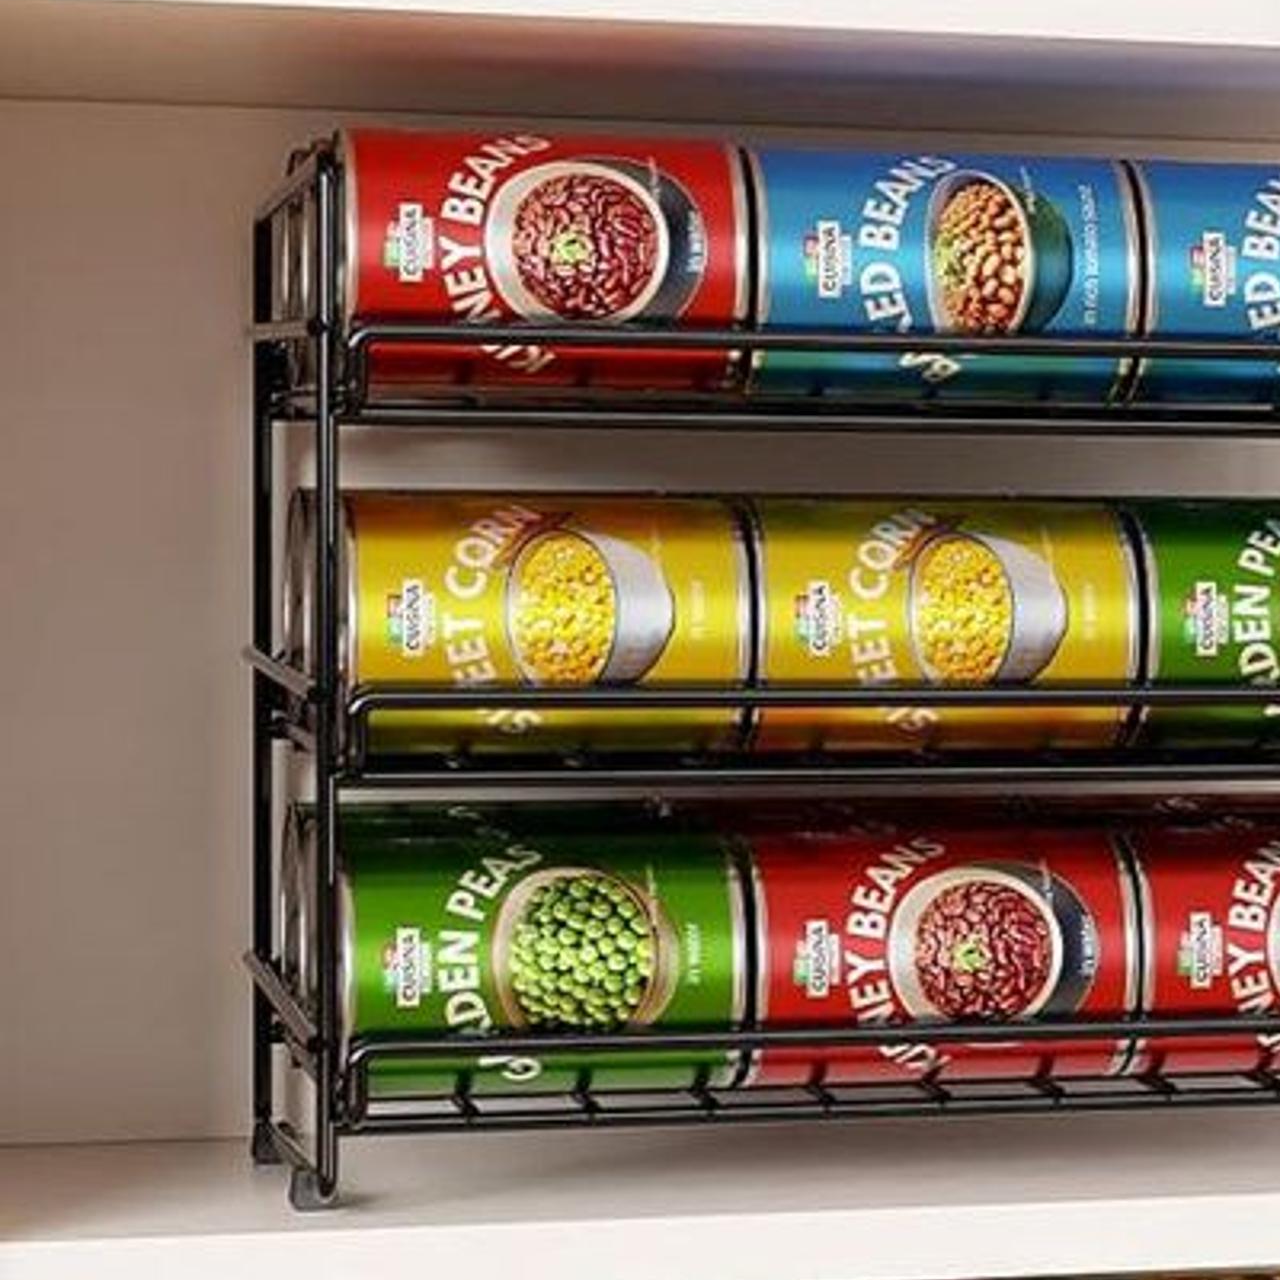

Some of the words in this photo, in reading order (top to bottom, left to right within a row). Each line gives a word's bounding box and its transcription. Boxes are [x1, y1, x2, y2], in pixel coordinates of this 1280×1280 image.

[440, 132, 552, 226] BEANS
[859, 153, 958, 251] BEANS
[444, 504, 542, 600] CORN
[849, 507, 938, 600] CORN
[446, 844, 542, 922] PEAS
[847, 835, 946, 939] BEANS
